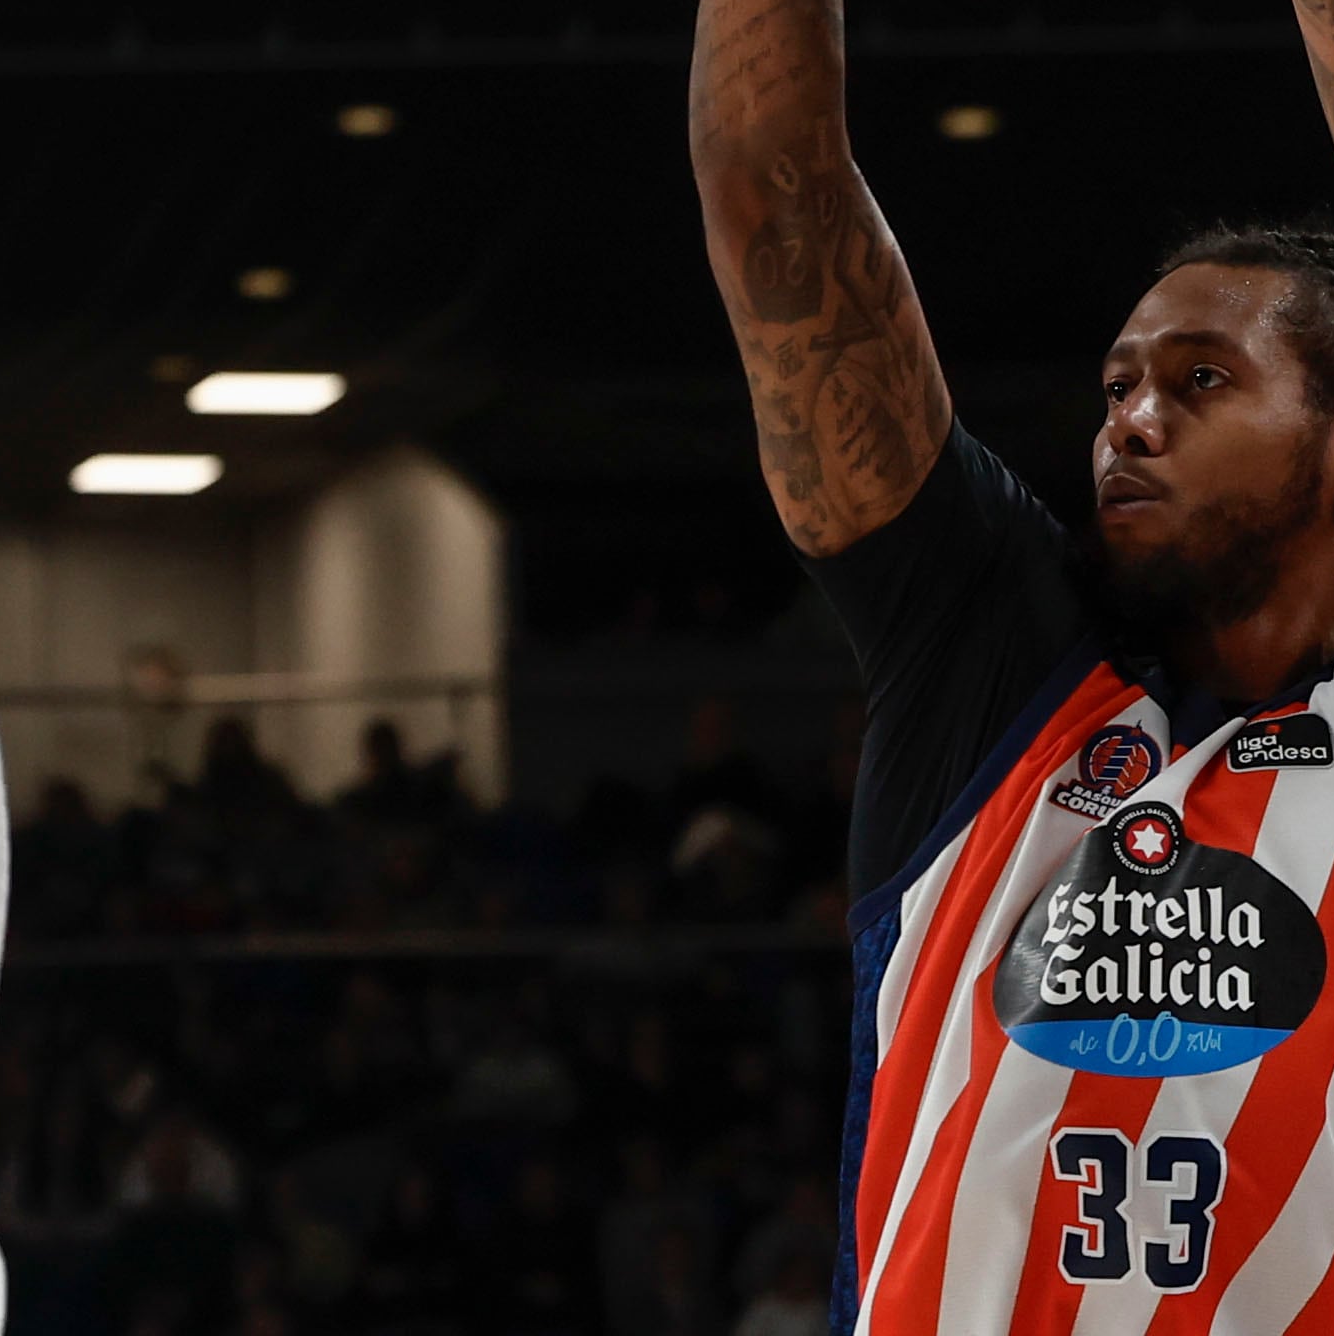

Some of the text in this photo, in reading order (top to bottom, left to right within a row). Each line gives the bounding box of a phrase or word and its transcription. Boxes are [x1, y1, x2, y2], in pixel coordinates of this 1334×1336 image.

[1237, 734, 1278, 752] liga
[1238, 745, 1328, 764] endesa
[1056, 791, 1117, 819] CORU
[1071, 785, 1123, 808] BASQU
[1116, 808, 1146, 830] ESTRELLA
[1041, 875, 1266, 949] Estrella
[1040, 942, 1255, 1012] Galicia
[1106, 1010, 1182, 1066] 0,0
[1049, 1127, 1228, 1295] 33
